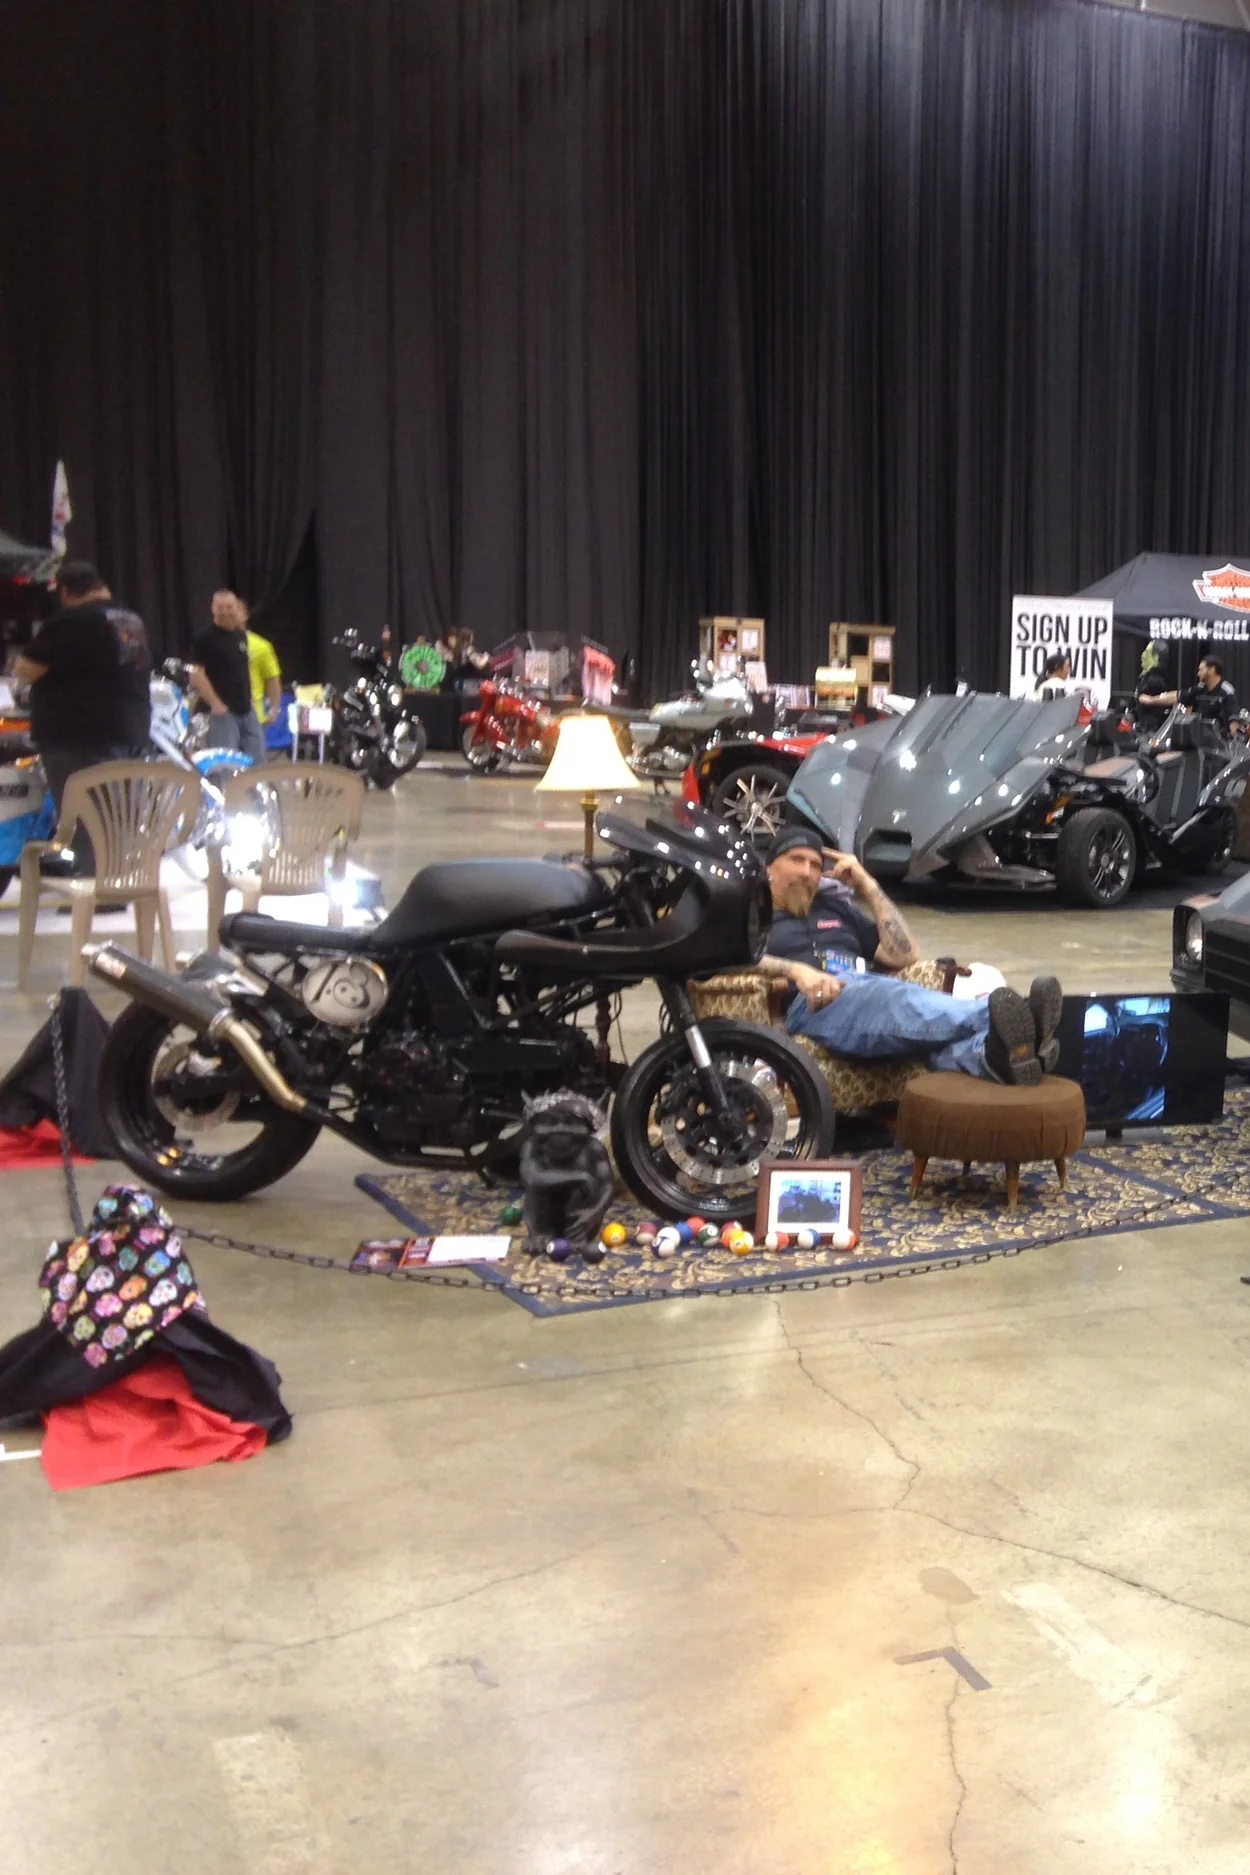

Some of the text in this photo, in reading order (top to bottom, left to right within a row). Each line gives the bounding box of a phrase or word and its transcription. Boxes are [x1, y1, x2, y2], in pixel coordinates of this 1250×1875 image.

[1016, 612, 1108, 645] SIGN UP
[1016, 644, 1107, 680] TO WIN
